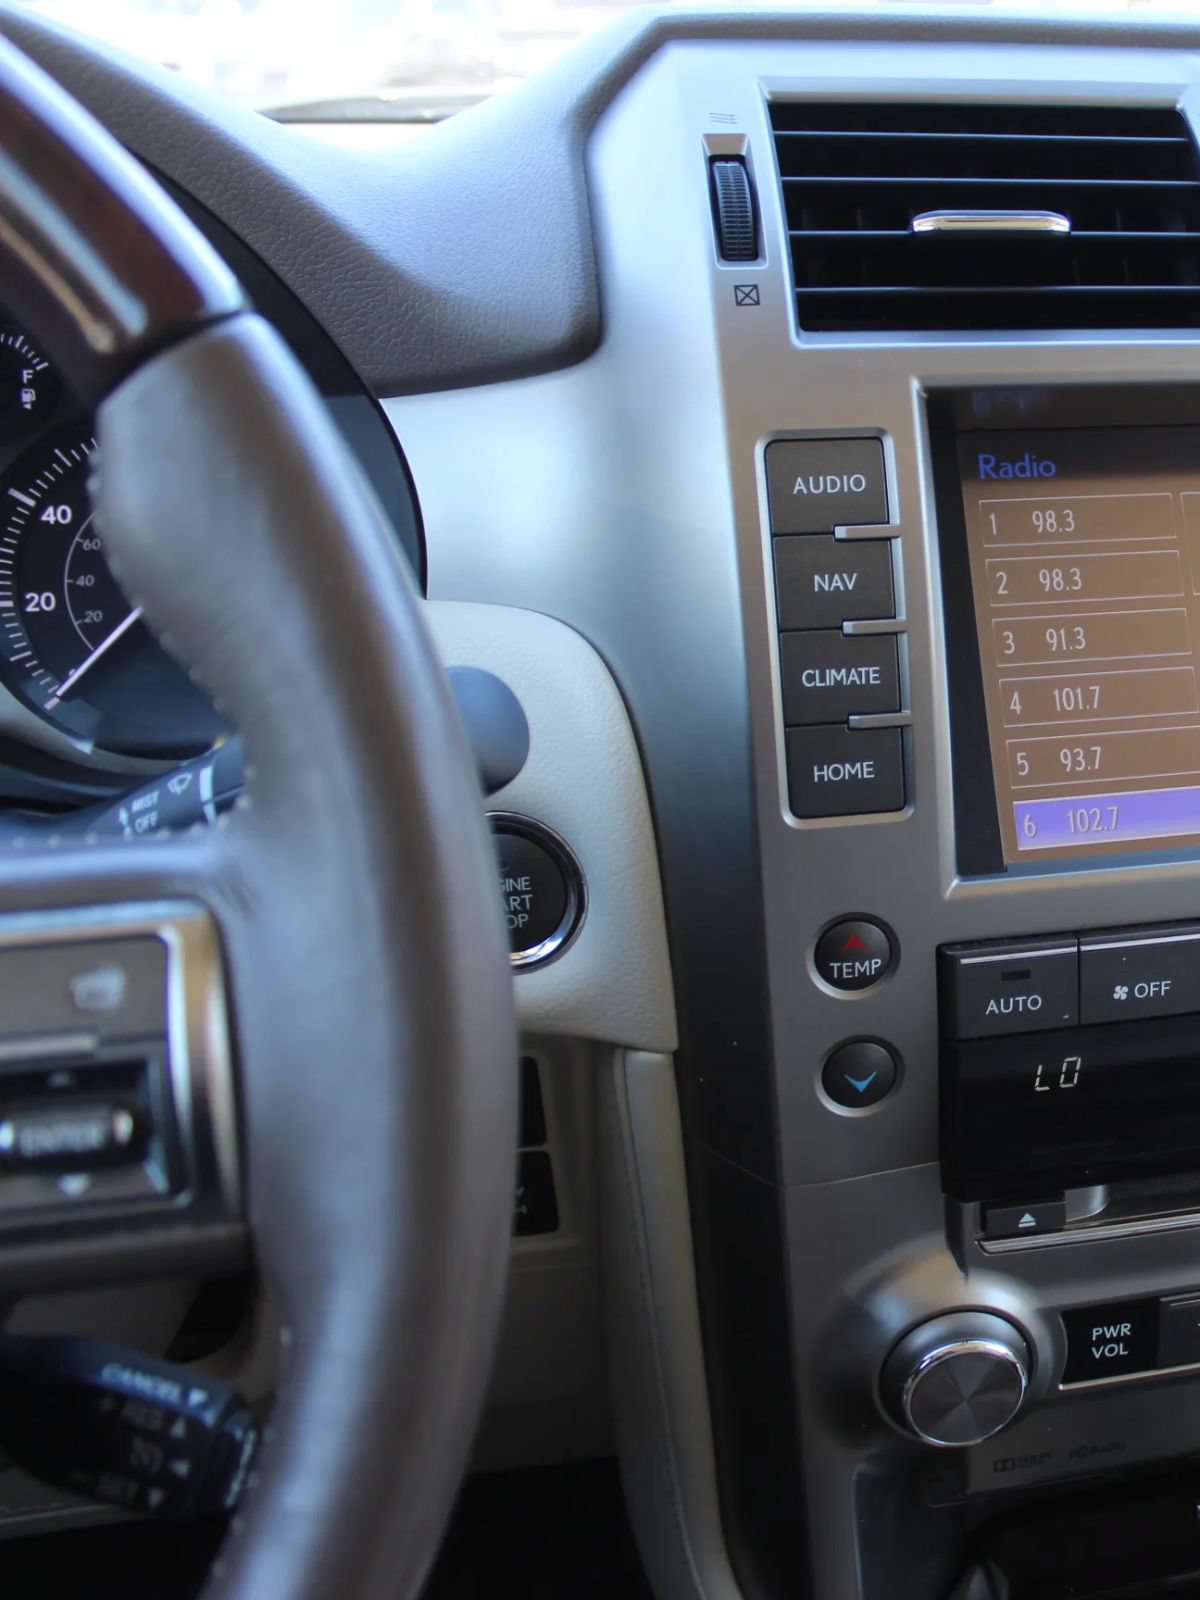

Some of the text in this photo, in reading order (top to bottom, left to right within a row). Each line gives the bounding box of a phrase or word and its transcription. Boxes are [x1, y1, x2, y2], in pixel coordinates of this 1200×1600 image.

[22, 370, 34, 383] F
[978, 453, 1057, 480] Radio
[793, 474, 866, 494] AUDIO
[41, 505, 72, 525] 40
[989, 509, 1076, 535] 1 98.3
[83, 538, 101, 550] 60
[76, 575, 95, 587] 40
[813, 573, 859, 592] NAV
[995, 568, 1083, 595] 2 98.3
[25, 592, 56, 612] 20
[84, 610, 103, 623] 20
[1003, 627, 1086, 654] 3 91.3
[802, 667, 881, 687] CLIMATE
[1010, 686, 1101, 715] 4 101.7
[1016, 746, 1102, 775] 5 93.7
[813, 762, 875, 782] HOME
[1023, 806, 1119, 838] 6 102.7
[506, 913, 529, 929] OP
[830, 959, 882, 979] TEMP
[1134, 981, 1171, 998] OFF
[985, 995, 1042, 1015] AUTO
[1092, 1323, 1131, 1341] PWR
[1092, 1343, 1129, 1359] VOL
